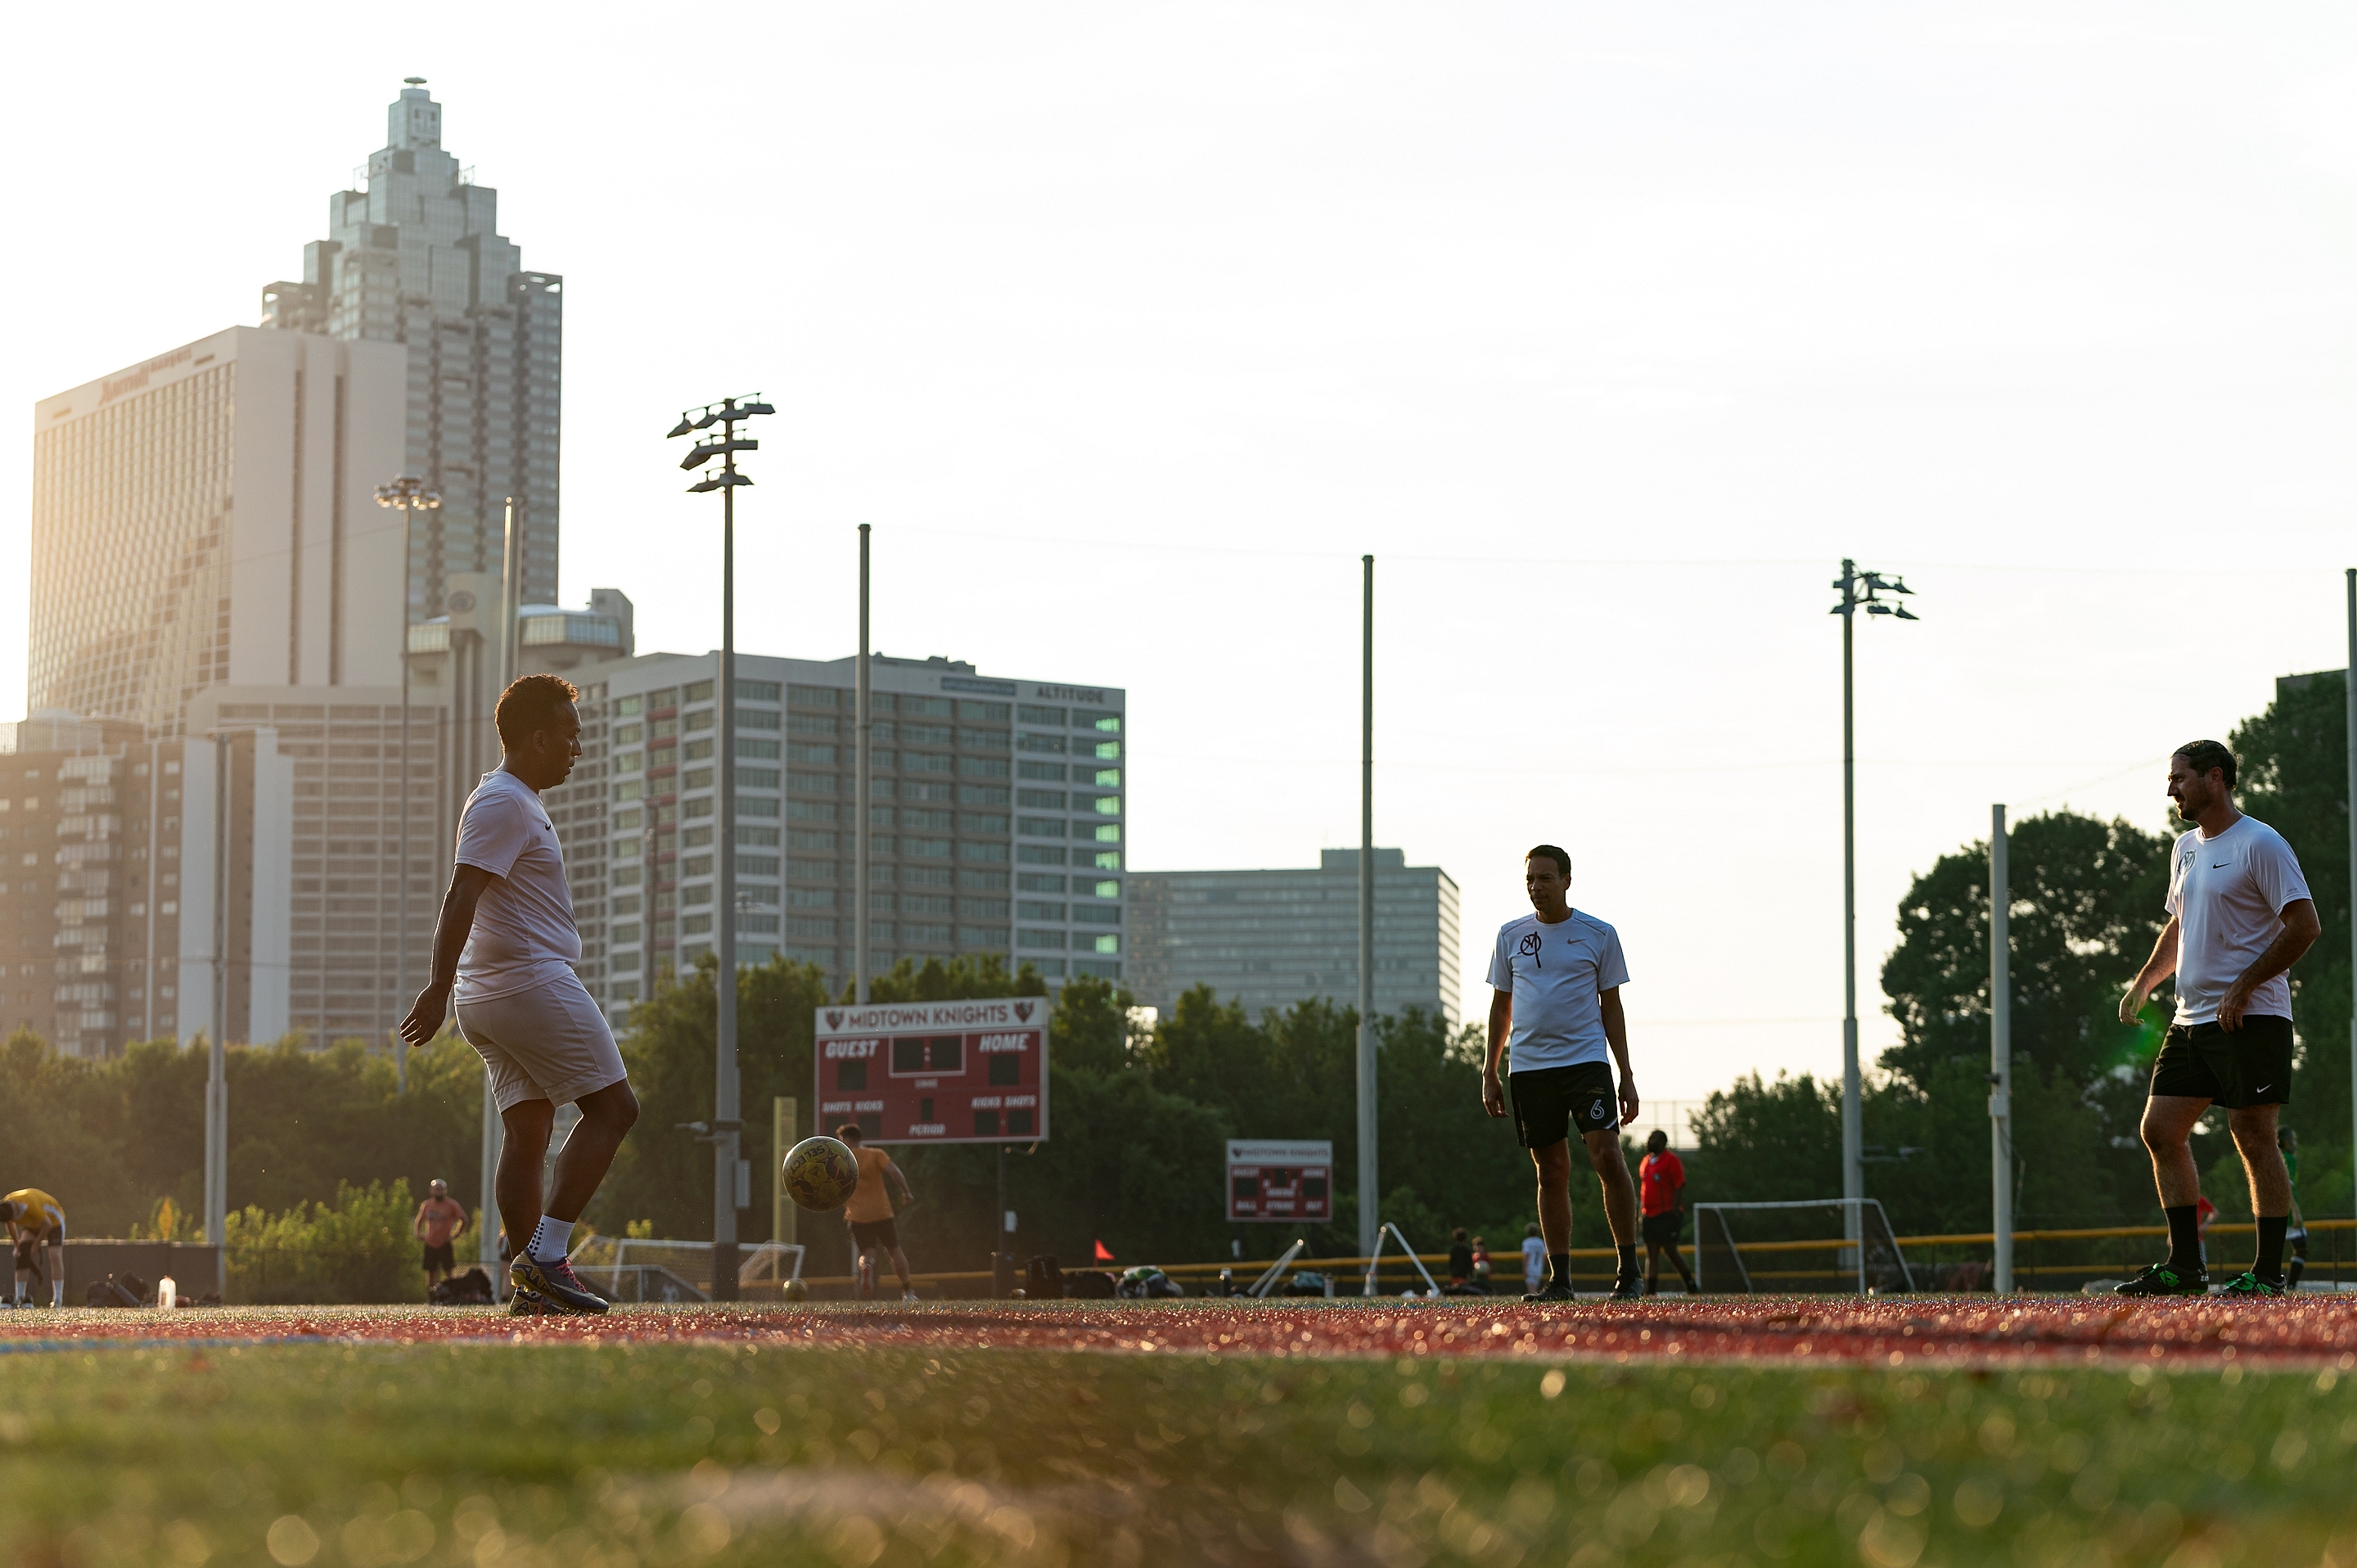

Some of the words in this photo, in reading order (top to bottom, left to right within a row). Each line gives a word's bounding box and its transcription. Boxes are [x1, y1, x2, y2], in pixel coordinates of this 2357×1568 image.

[1036, 686, 1103, 703] ALTITUDE
[849, 1010, 927, 1028] MIDTOWN
[933, 1005, 1008, 1024] KNIGHTS
[825, 1040, 879, 1058] GUEST
[979, 1034, 1030, 1052] HOME
[1590, 1099, 1605, 1120] 6
[909, 1124, 945, 1136] PERIOD
[790, 1146, 826, 1174] SELECT
